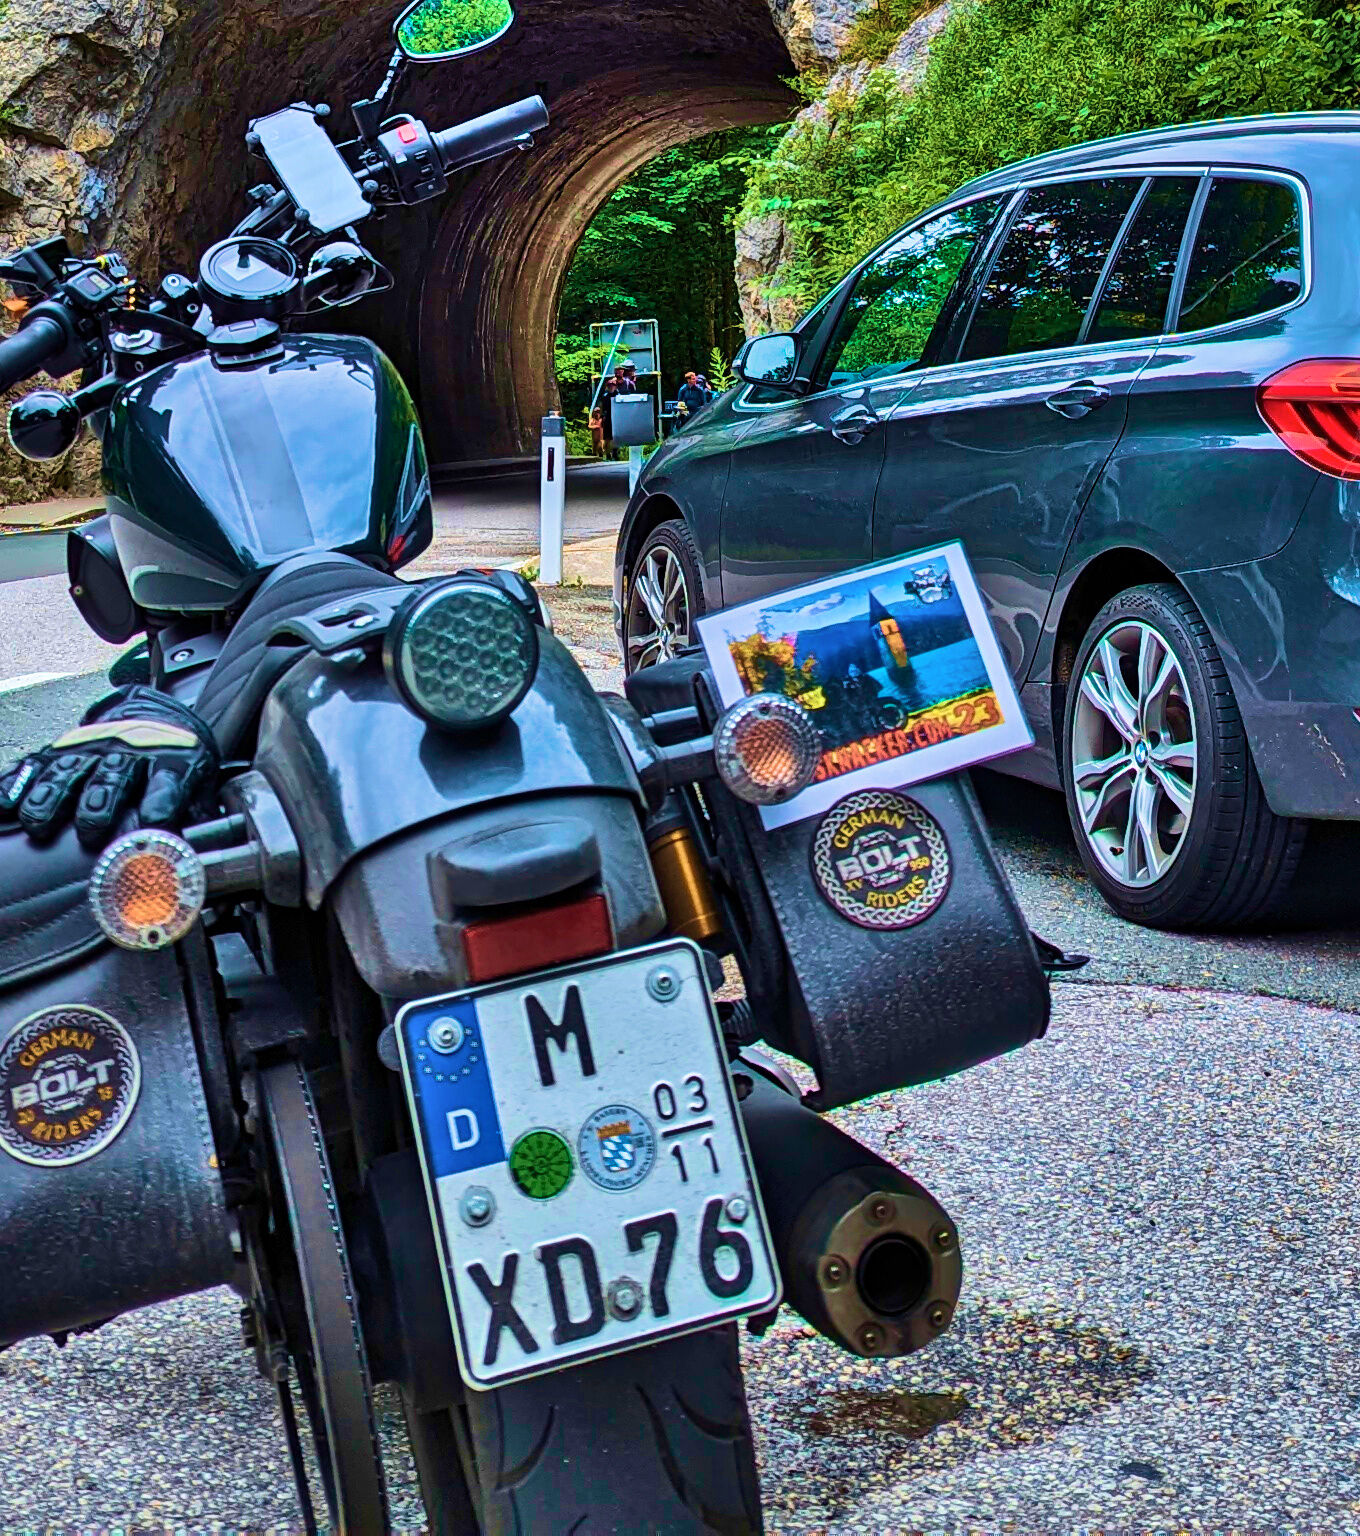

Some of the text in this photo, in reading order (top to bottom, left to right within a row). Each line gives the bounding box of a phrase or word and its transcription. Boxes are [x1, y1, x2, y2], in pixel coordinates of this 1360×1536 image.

[954, 696, 1000, 734] 23
[834, 809, 906, 848] GERMAN
[836, 835, 921, 881] BOLT
[866, 875, 927, 908] RIDERS
[18, 1027, 96, 1069] GERMAN
[524, 983, 598, 1088] M
[11, 1058, 115, 1110] BOLT
[654, 1074, 709, 1121] 03
[31, 1107, 102, 1141] RIDERS
[446, 1107, 480, 1151] D
[669, 1136, 720, 1183] 11
[467, 1198, 755, 1366] XD 76
